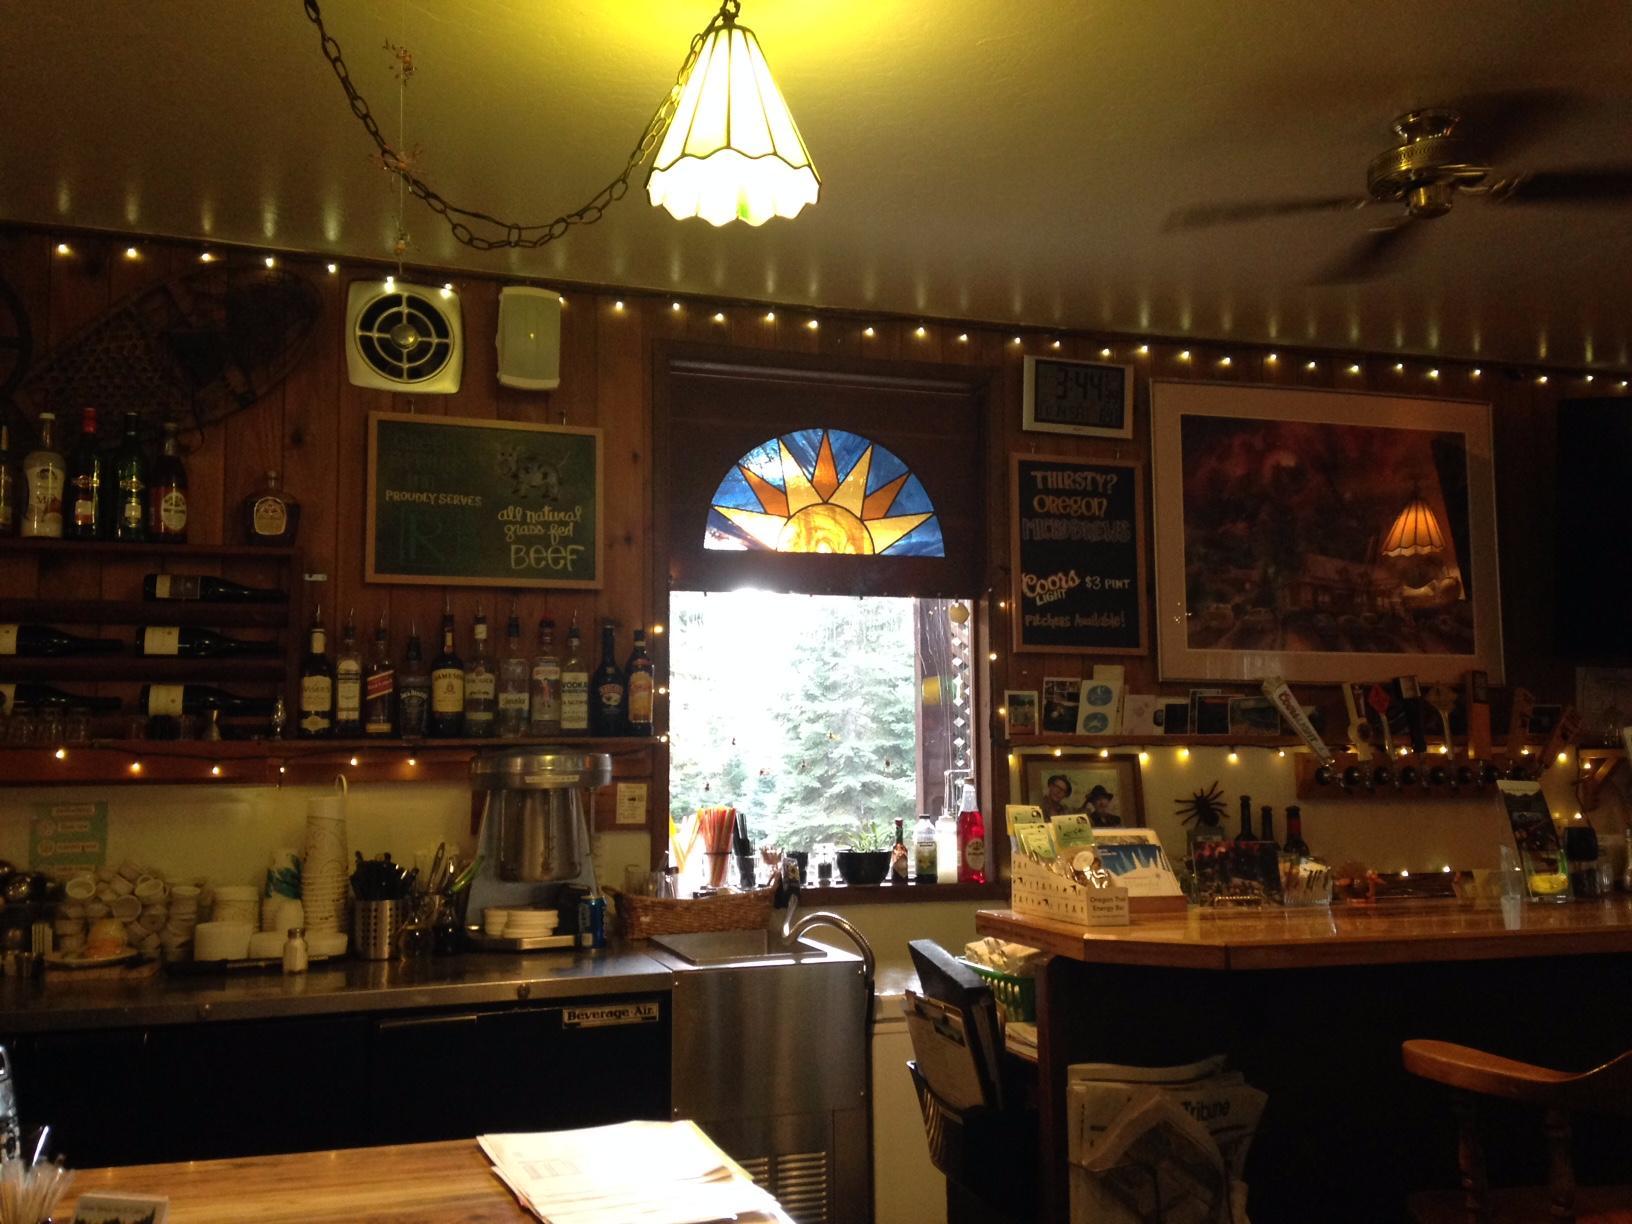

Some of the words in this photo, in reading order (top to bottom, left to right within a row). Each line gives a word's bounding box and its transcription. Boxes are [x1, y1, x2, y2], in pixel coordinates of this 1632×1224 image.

[1031, 470, 1118, 494] THIRSTY?
[385, 489, 438, 506] PROUDLY
[438, 493, 483, 507] SERVES
[497, 505, 522, 522] all
[525, 504, 582, 523] natural
[504, 524, 545, 542] grass
[1021, 569, 1081, 598] Coors
[1085, 575, 1102, 590] $3
[1104, 578, 1131, 590] PINT
[1035, 588, 1067, 607] LIGHT
[1180, 1099, 1231, 1122] Tribune
